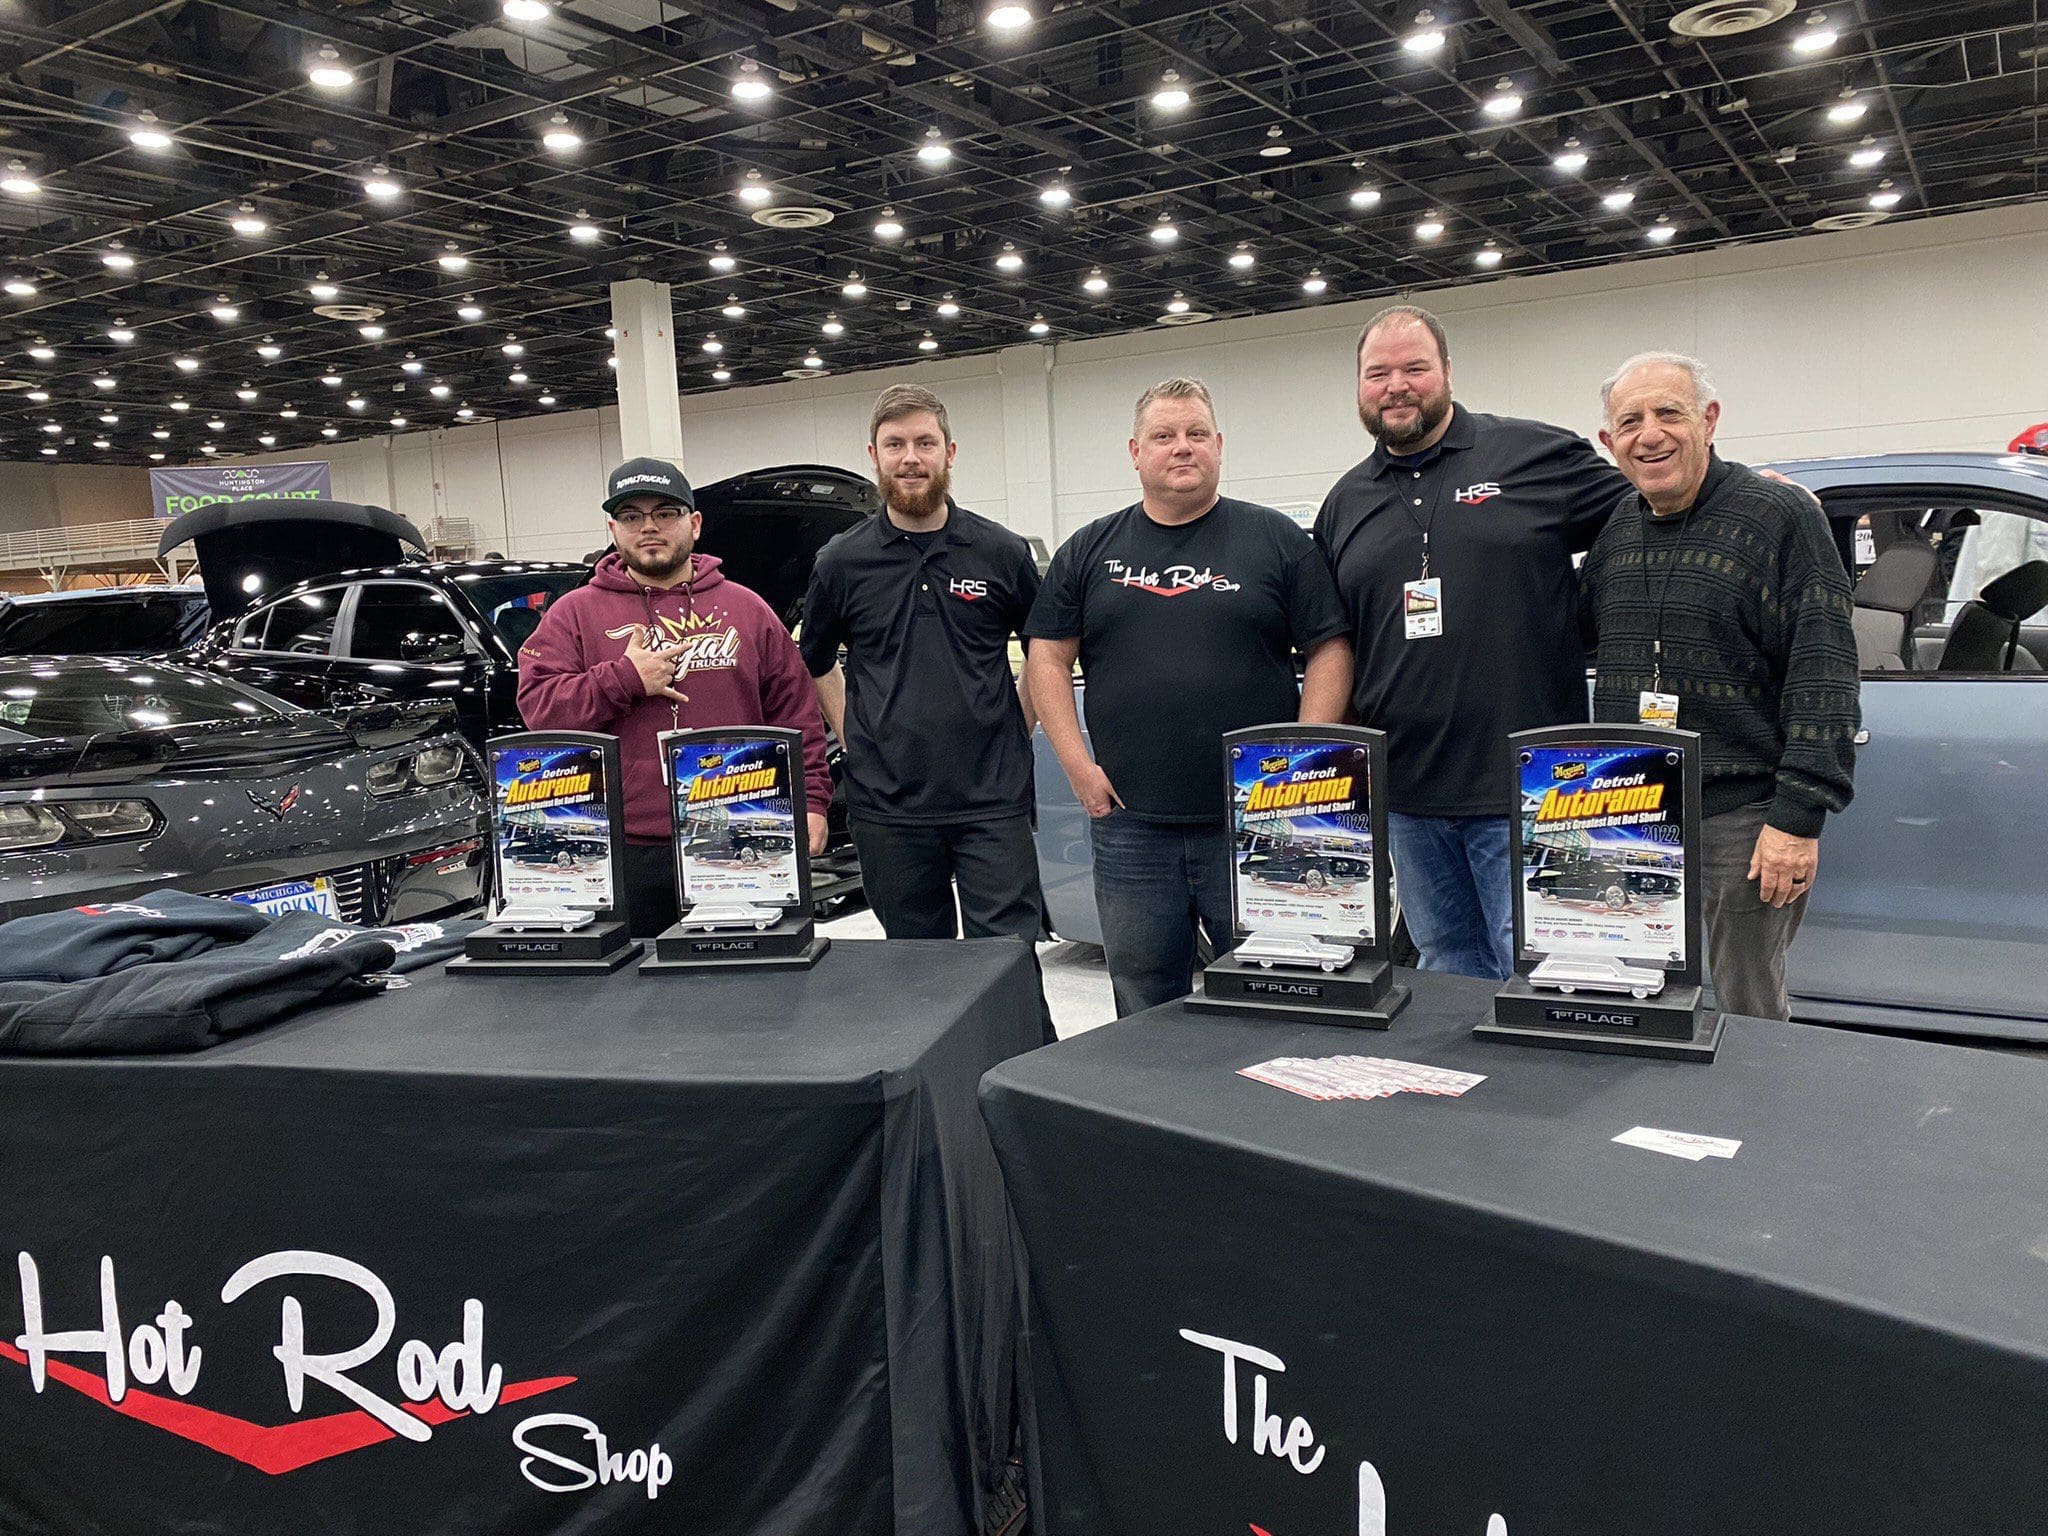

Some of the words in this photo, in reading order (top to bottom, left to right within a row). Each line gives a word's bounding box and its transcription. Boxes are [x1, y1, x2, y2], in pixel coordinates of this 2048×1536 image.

[219, 478, 265, 486] HUNTINGTON
[1455, 482, 1502, 502] HRS
[1104, 559, 1125, 573] The
[1122, 566, 1160, 587] Hot
[1163, 565, 1213, 589] Rod
[1211, 578, 1241, 592] Shop
[949, 578, 987, 596] HRS
[689, 657, 738, 669] TRUCKIN
[542, 765, 579, 779] Detroit
[725, 760, 764, 775] Detroit
[1291, 766, 1338, 782] Detroit
[505, 773, 591, 805] Autorama
[687, 767, 777, 803] Autorama
[1592, 773, 1646, 789] Detroit
[1245, 776, 1354, 811] Autorama
[1536, 782, 1665, 821] Autorama
[1336, 813, 1369, 832] 2022
[1533, 821, 1572, 834] America's
[1572, 817, 1607, 830] Greatest
[1607, 815, 1621, 826] Hot
[1622, 813, 1638, 824] Rod
[1641, 824, 1680, 845] 2022
[256, 884, 307, 902] MICHIGAN
[502, 943, 518, 951] 1ST
[518, 943, 559, 951] PLACE
[696, 943, 712, 951] 1ST
[712, 942, 755, 951] PLACE
[1248, 981, 1267, 991] 1ST
[1268, 983, 1319, 996] PLACE
[1551, 1010, 1573, 1020] 1ST
[1574, 1012, 1635, 1026] PLACE
[15, 1250, 202, 1402] Hot
[221, 1250, 503, 1442] Rod
[1178, 1328, 1327, 1475] The
[512, 1413, 673, 1500] Shop
